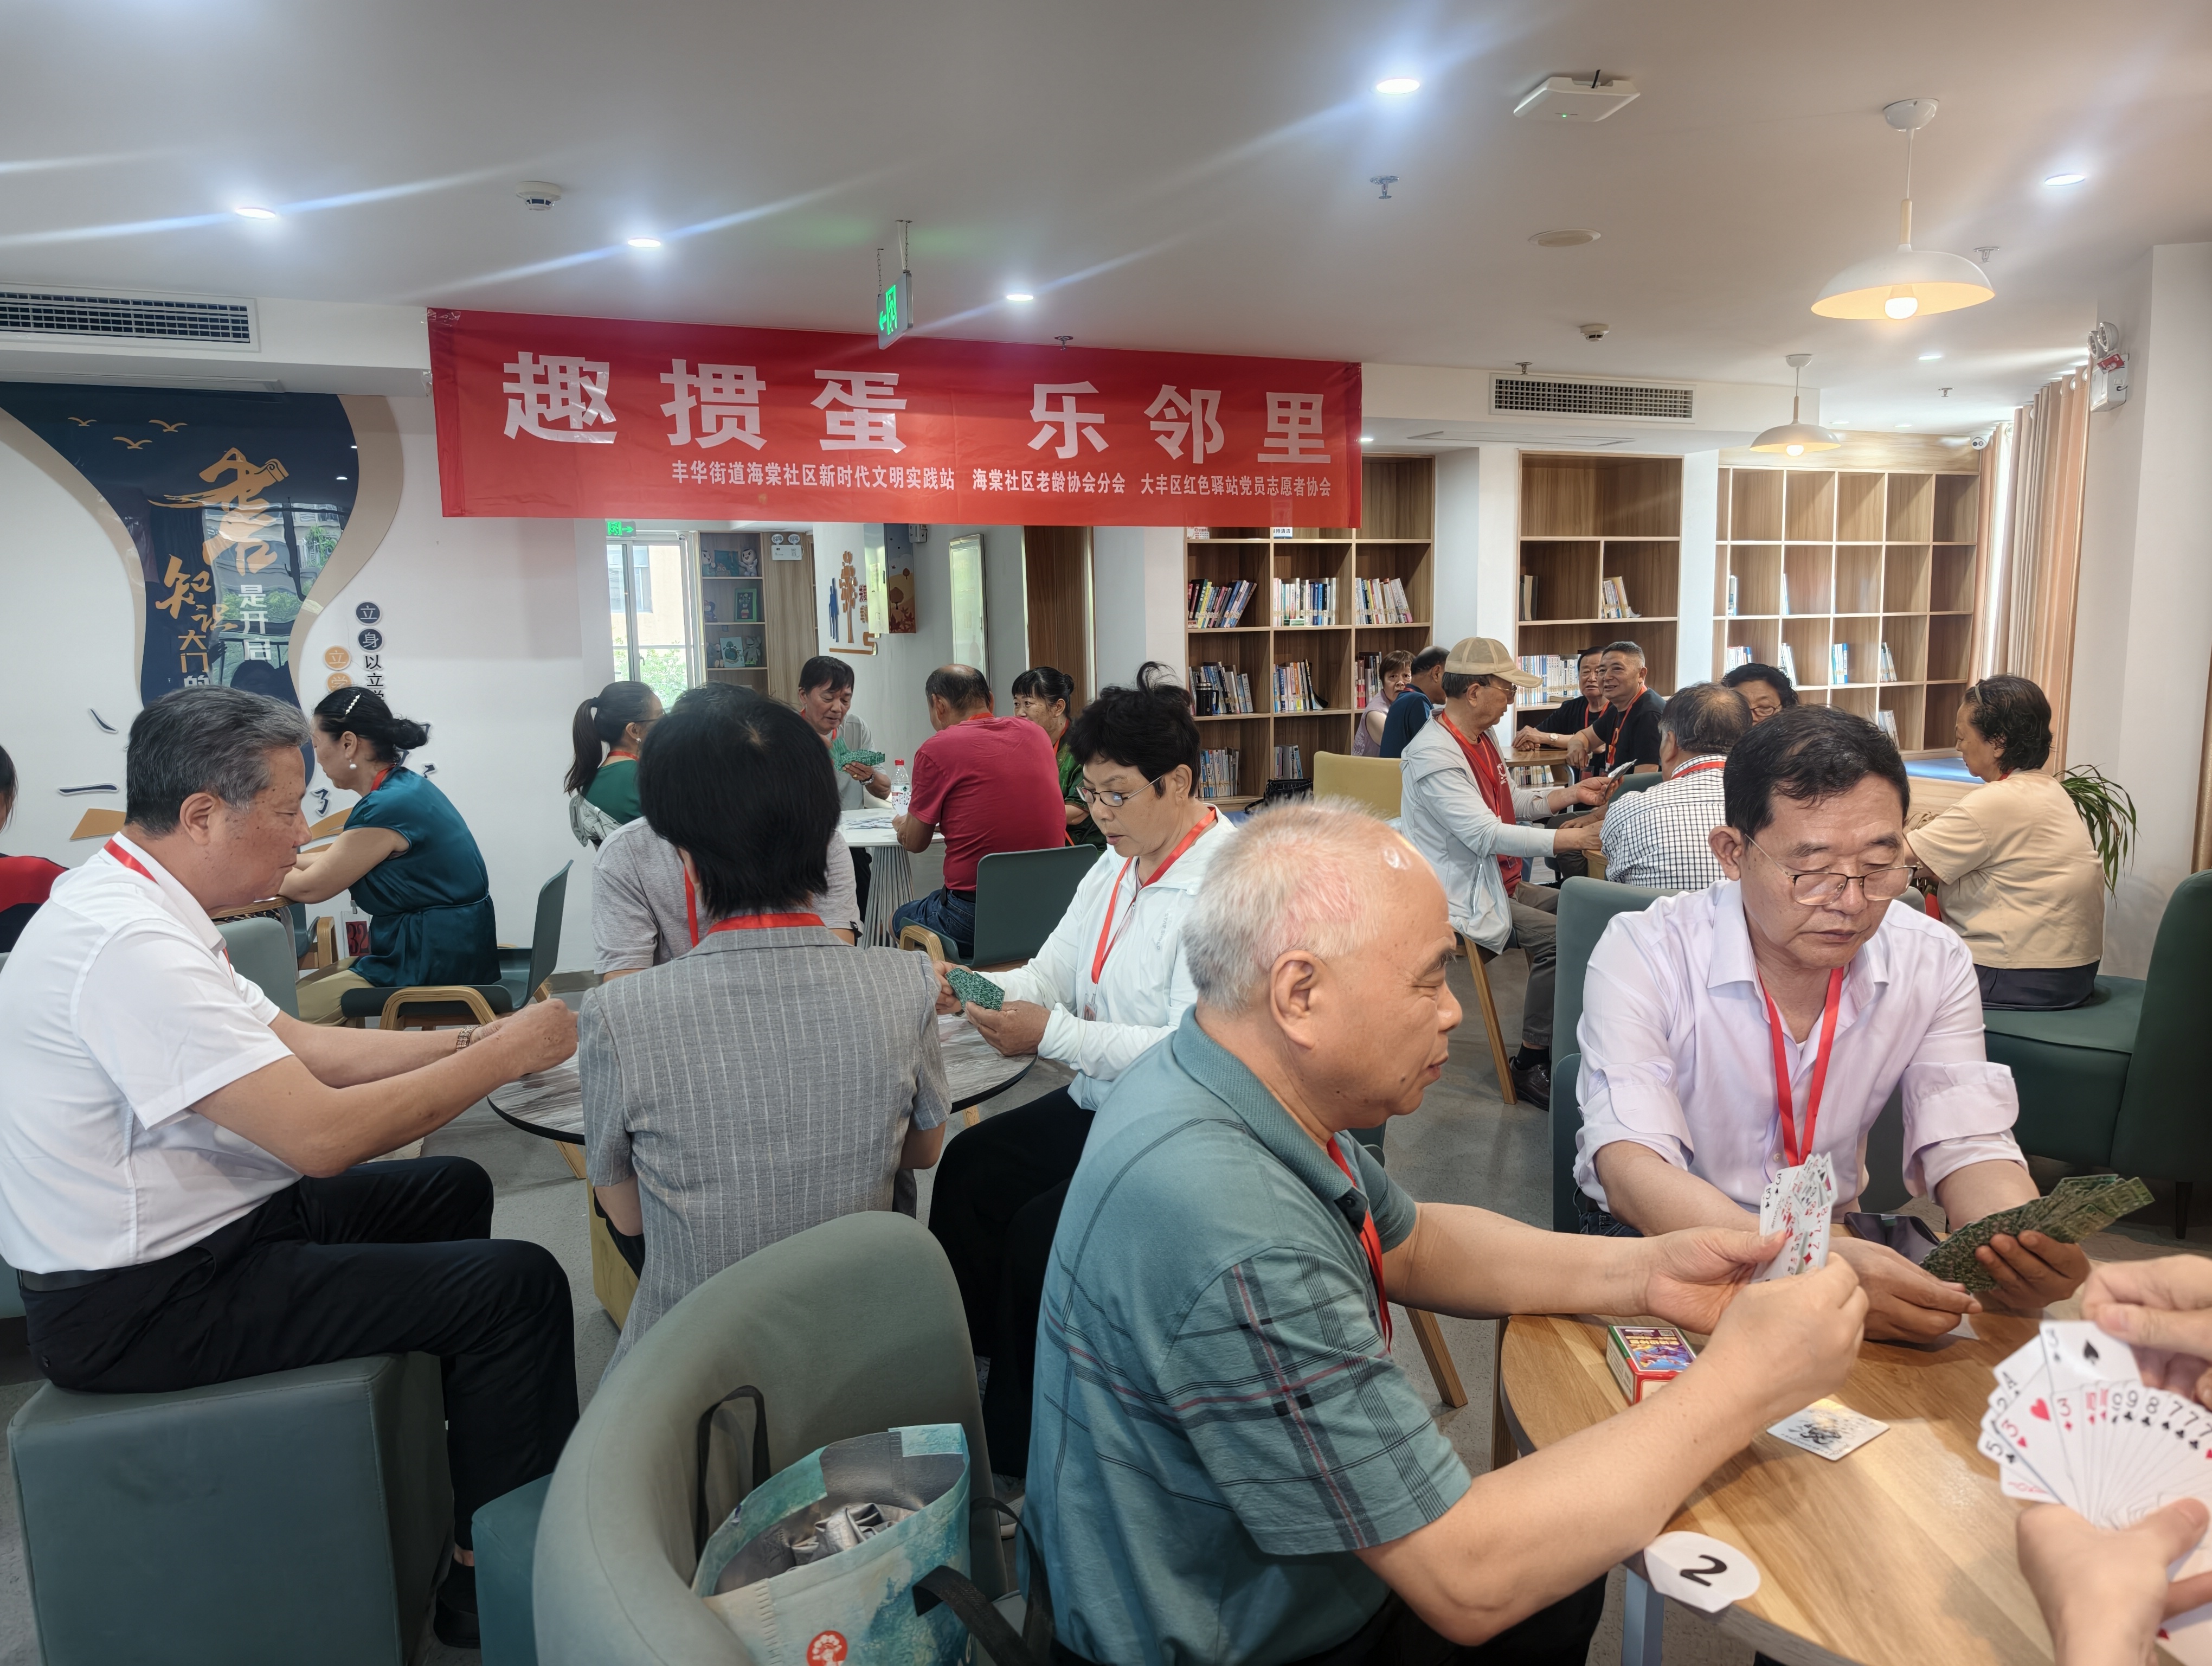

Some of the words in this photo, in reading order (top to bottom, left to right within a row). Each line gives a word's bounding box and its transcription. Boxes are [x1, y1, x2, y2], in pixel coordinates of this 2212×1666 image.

[503, 351, 908, 453] 趣掼蛋
[1027, 381, 1331, 464] 乐邻里
[672, 459, 955, 490] 丰华街道海棠社区新时代文明实践站
[972, 468, 1126, 494] 海棠社区老龄协会分会
[1141, 473, 1332, 497] 大丰区红色驿站党员志愿者协会
[155, 554, 239, 633] 知识
[238, 584, 272, 661] 是开启
[1776, 1173, 1782, 1185] 3
[1765, 1187, 1771, 1200] 3
[2056, 1398, 2071, 1417] 3
[2126, 1389, 2138, 1408] 9
[2145, 1396, 2159, 1414] 8
[2169, 1400, 2183, 1417] 7
[2183, 1411, 2199, 1426] 7
[1985, 1440, 2003, 1457] 5
[1679, 1554, 1728, 1587] 2
